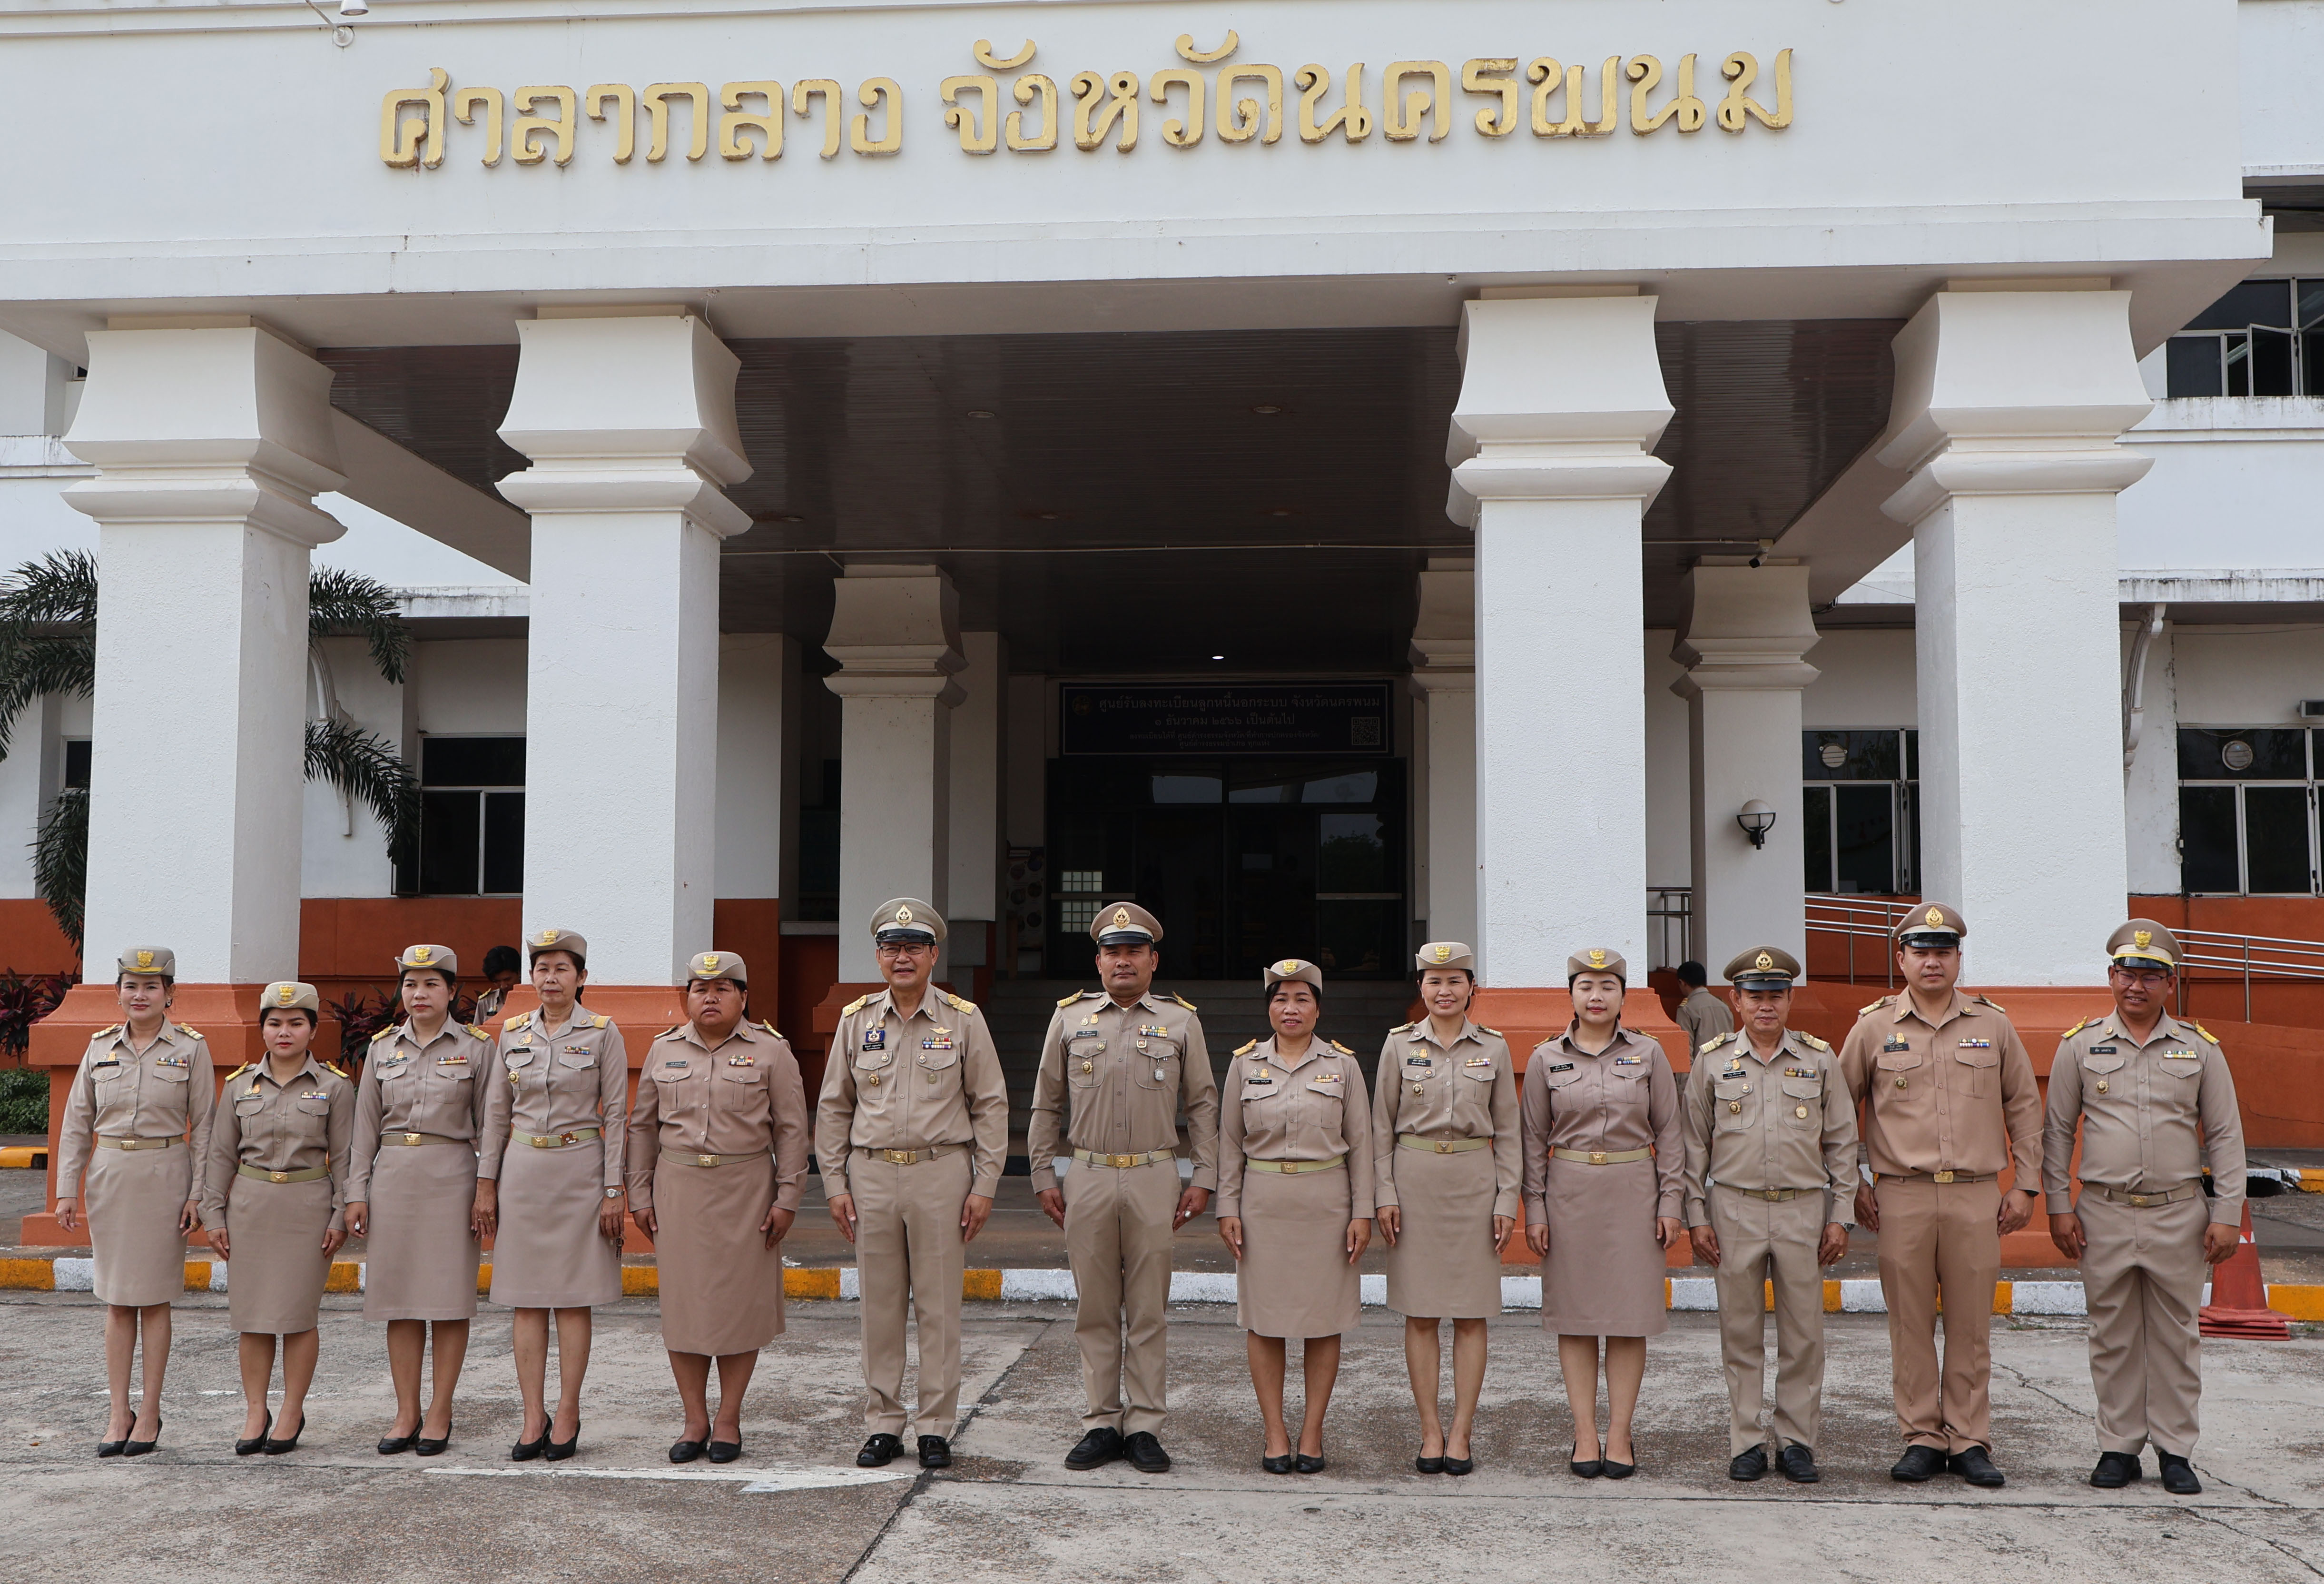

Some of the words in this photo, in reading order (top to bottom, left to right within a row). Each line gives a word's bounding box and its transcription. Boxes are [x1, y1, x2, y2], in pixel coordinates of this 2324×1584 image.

[380, 67, 903, 169] ศาลากลาง
[940, 29, 1794, 156] จังหวัดนครพนม
[1099, 692, 1287, 712] ศูนย์รับลงทะเบียนลูกหนี้นอกระบบ
[1291, 694, 1379, 707] จังหวัดนครพนม
[1166, 713, 1207, 726] ธันวาคม
[1212, 716, 1242, 725] ๒๕๖๖
[1247, 712, 1295, 725] เป็นต้นไป
